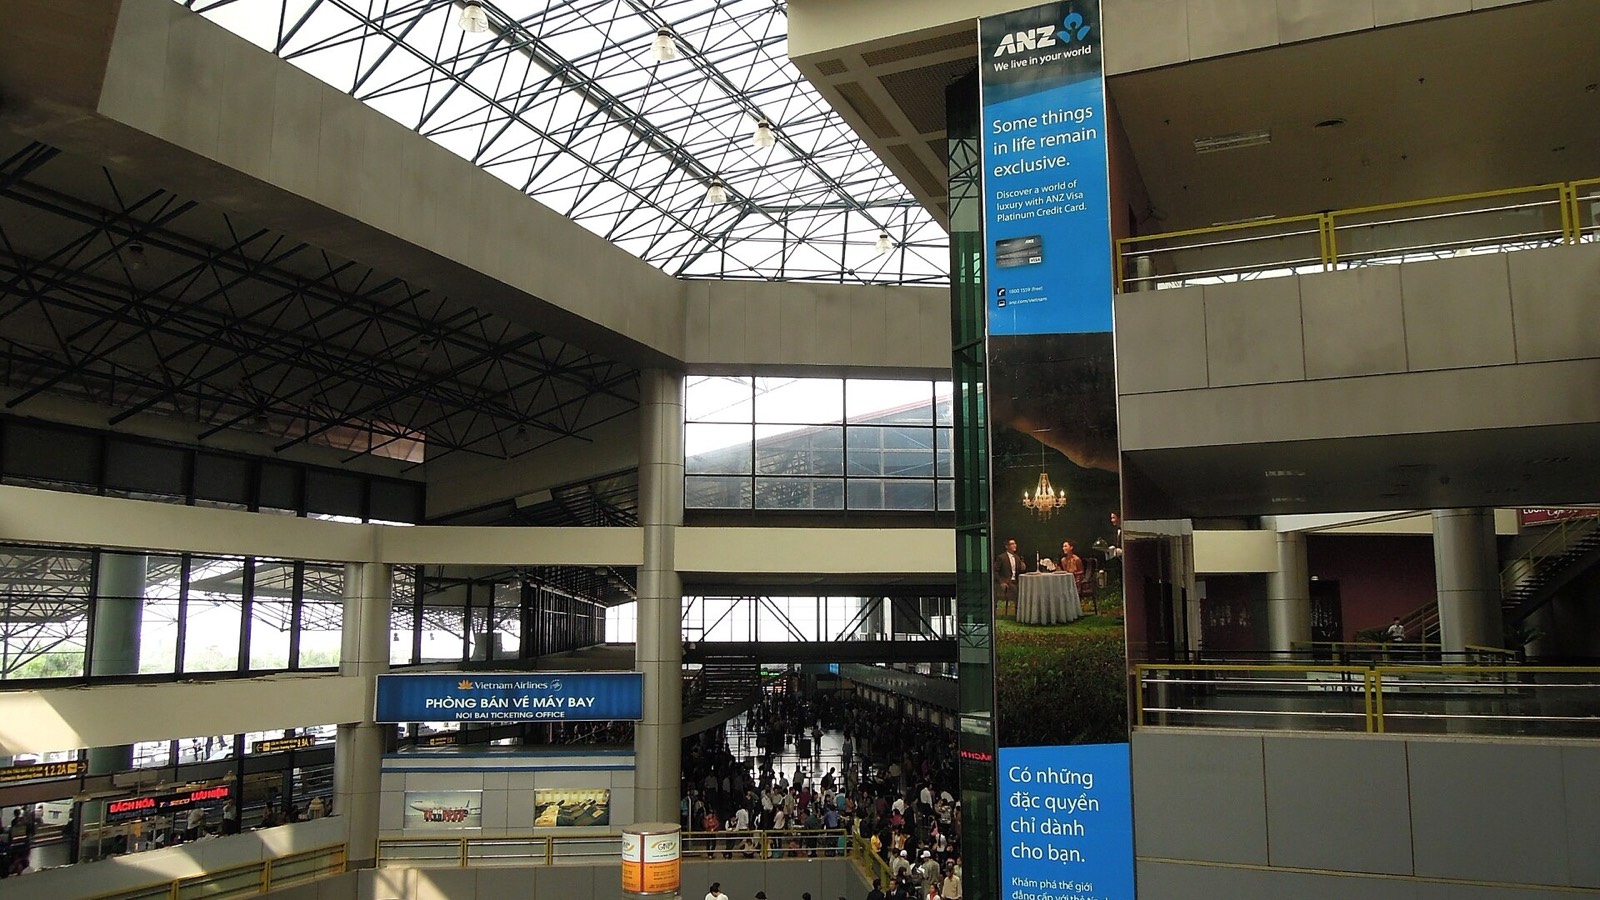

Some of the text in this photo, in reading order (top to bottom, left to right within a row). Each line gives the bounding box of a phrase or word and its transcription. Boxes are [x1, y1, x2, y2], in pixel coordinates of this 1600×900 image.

[993, 25, 1055, 57] ANZ
[994, 45, 1092, 72] We live in your world
[993, 107, 1092, 134] Some things
[994, 128, 1097, 155] in life remain
[994, 156, 1070, 177] exclusive.
[997, 188, 1032, 199] Discover
[1041, 182, 1065, 192] world
[1068, 180, 1077, 188] of
[997, 192, 1083, 211] luxury with ANZ Visa
[997, 203, 1086, 222] Platinum Credit Card.
[475, 682, 512, 690] Vietnam
[426, 695, 595, 708] PHÒNG BÁN VÉ MÁY BAY
[1009, 766, 1093, 789] Có những
[110, 800, 135, 813] BÁCH
[1010, 791, 1099, 814] đặc quyền
[1011, 816, 1084, 836] chỉ dành
[1011, 842, 1085, 865] cho bạn.
[1012, 877, 1093, 892] Khám phá thế giới
